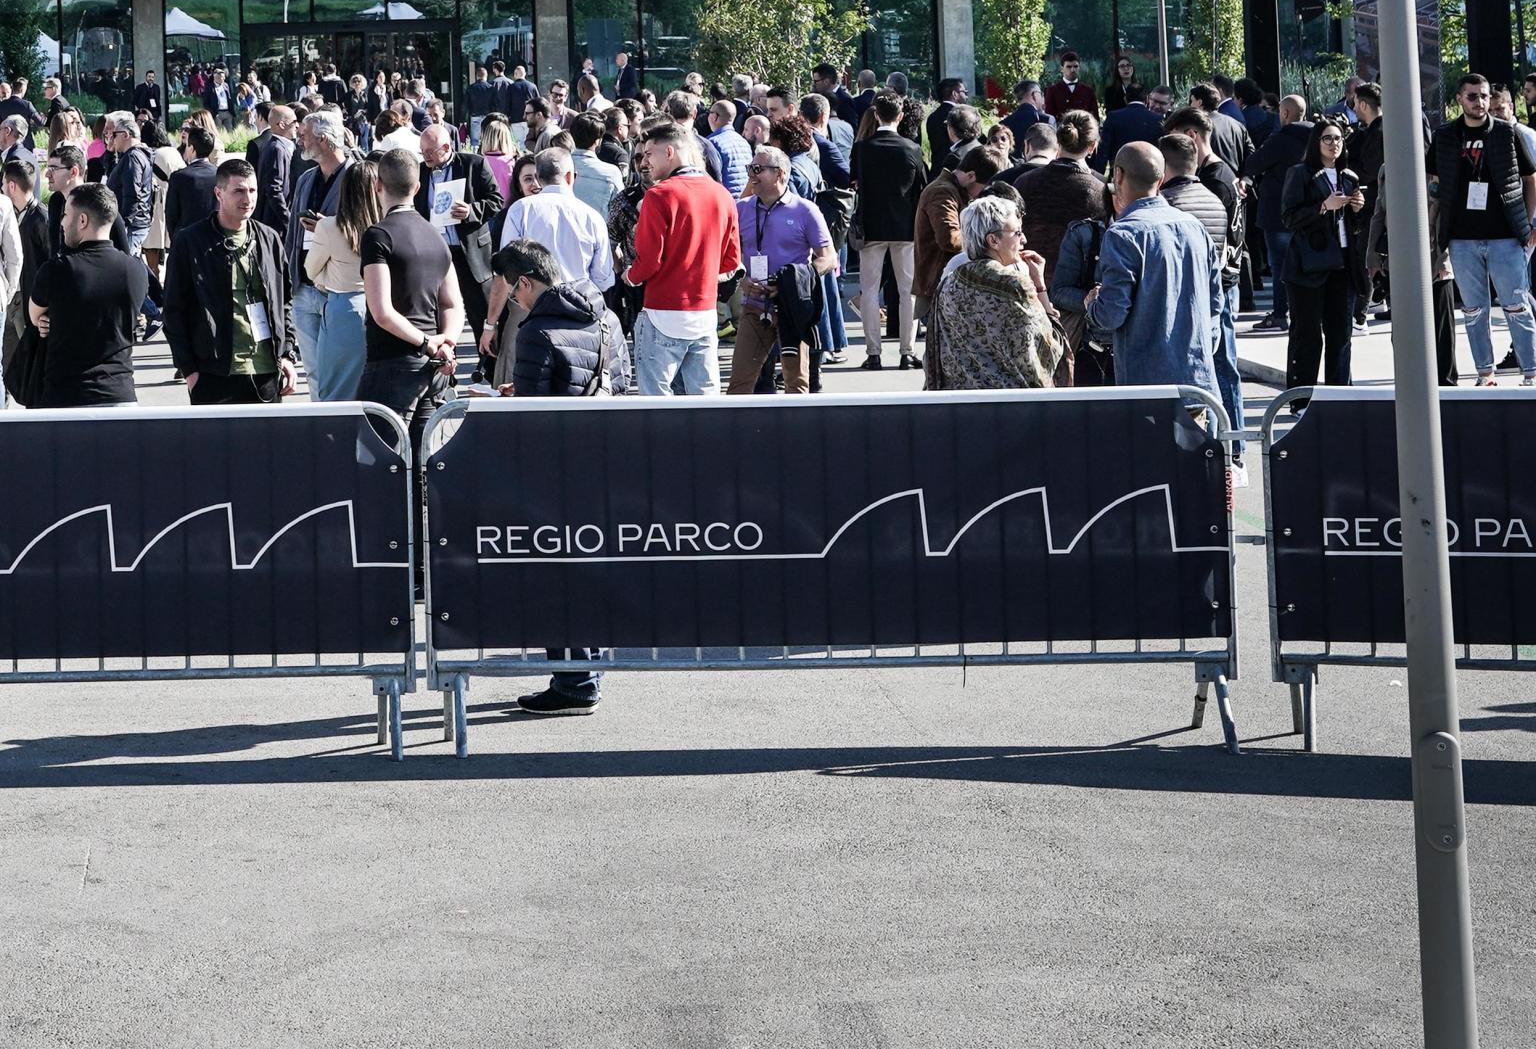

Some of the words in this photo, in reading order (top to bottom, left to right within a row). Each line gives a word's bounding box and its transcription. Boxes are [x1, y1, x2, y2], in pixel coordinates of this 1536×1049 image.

[1225, 471, 1233, 512] ALTRAD
[476, 524, 604, 554] REGIO
[618, 521, 764, 552] PARCO
[1322, 517, 1460, 547] REG
[1474, 518, 1534, 547] PA
